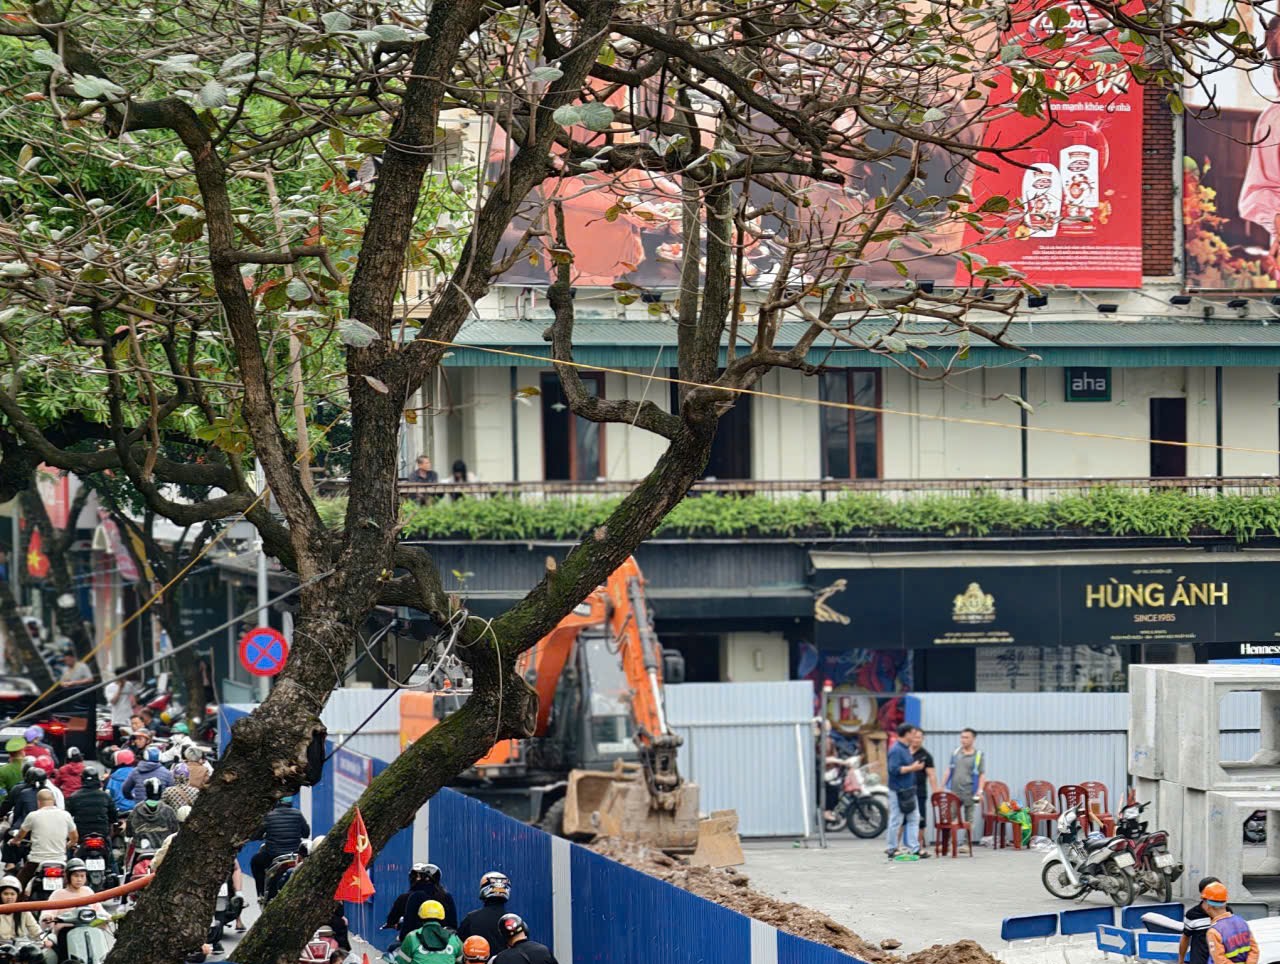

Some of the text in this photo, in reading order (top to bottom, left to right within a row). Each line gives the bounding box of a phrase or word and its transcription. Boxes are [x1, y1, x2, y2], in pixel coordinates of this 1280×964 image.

[1072, 372, 1106, 391] aha
[1086, 575, 1229, 608] HÙNG ÁNH
